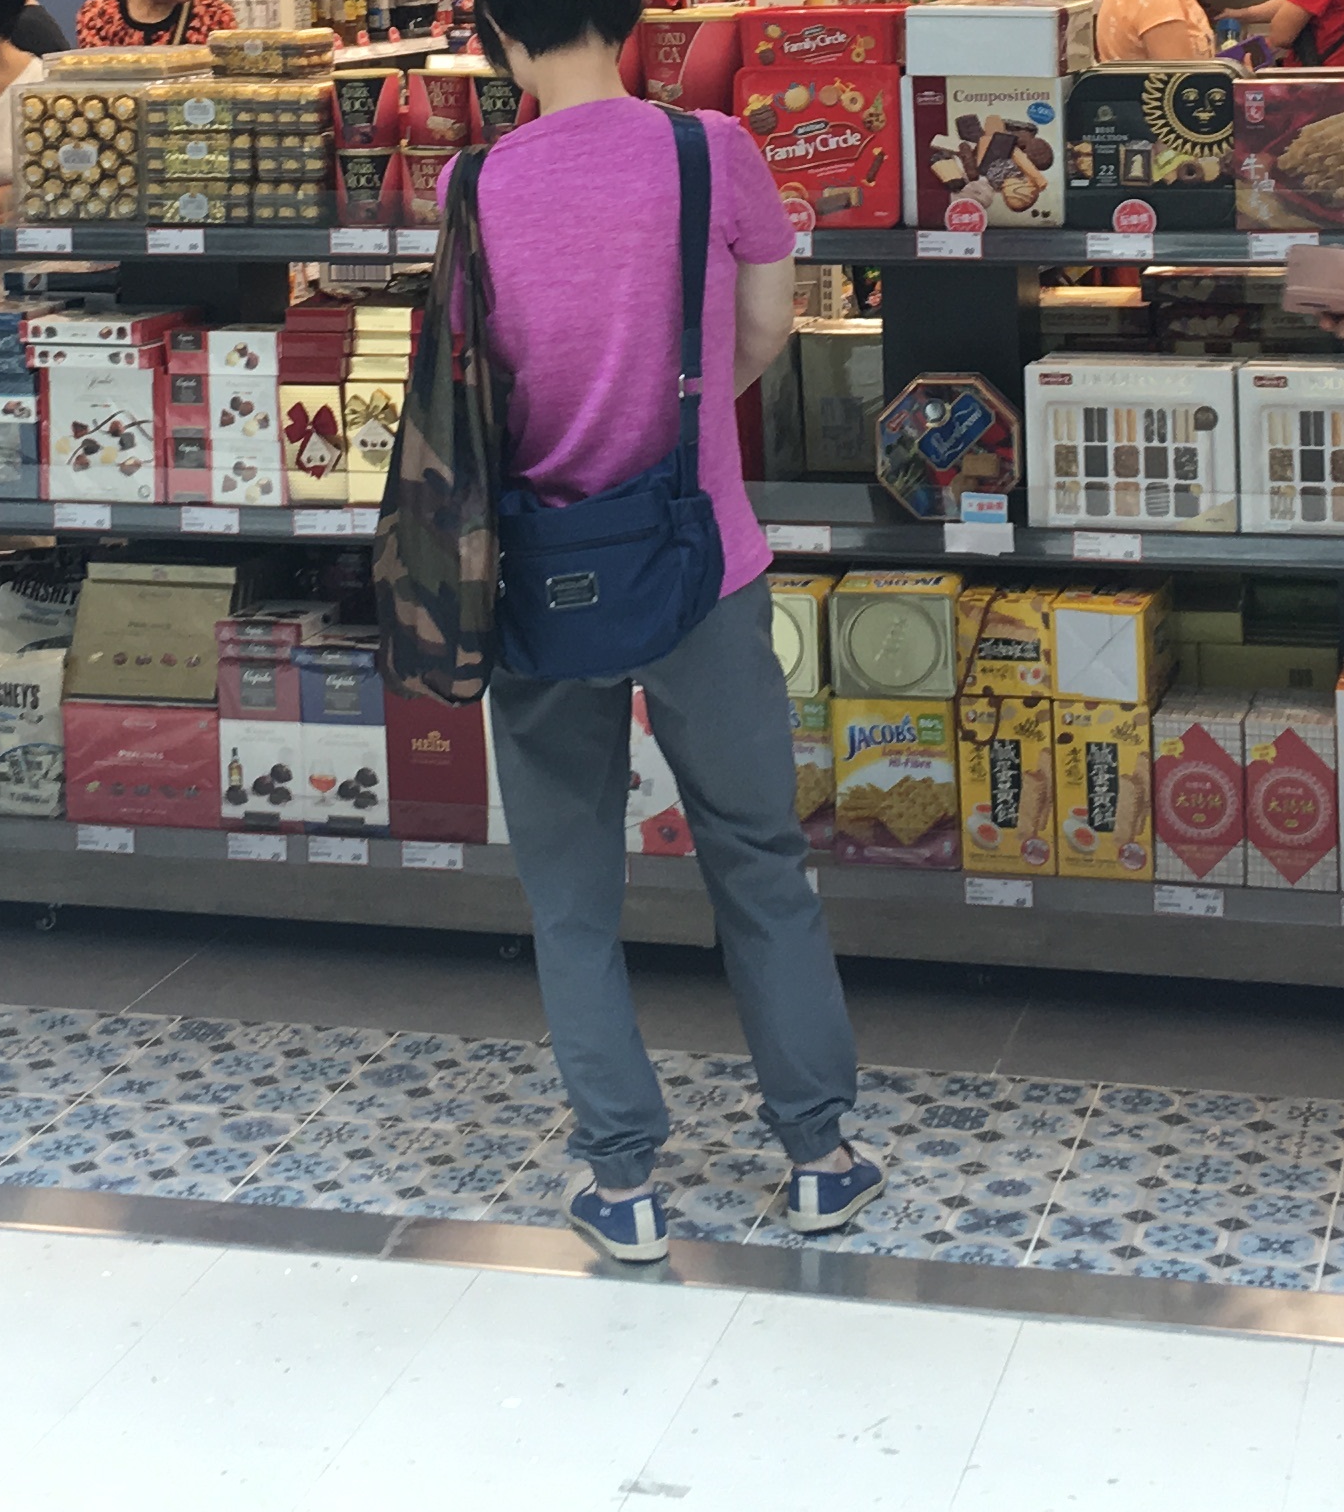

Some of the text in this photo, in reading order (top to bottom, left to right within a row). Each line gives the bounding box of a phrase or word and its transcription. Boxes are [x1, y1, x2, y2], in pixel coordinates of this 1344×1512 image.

[953, 88, 1051, 107] Composition
[1098, 164, 1115, 176] 22
[411, 737, 452, 753] HEIDI
[842, 713, 919, 761] JACOB'S
